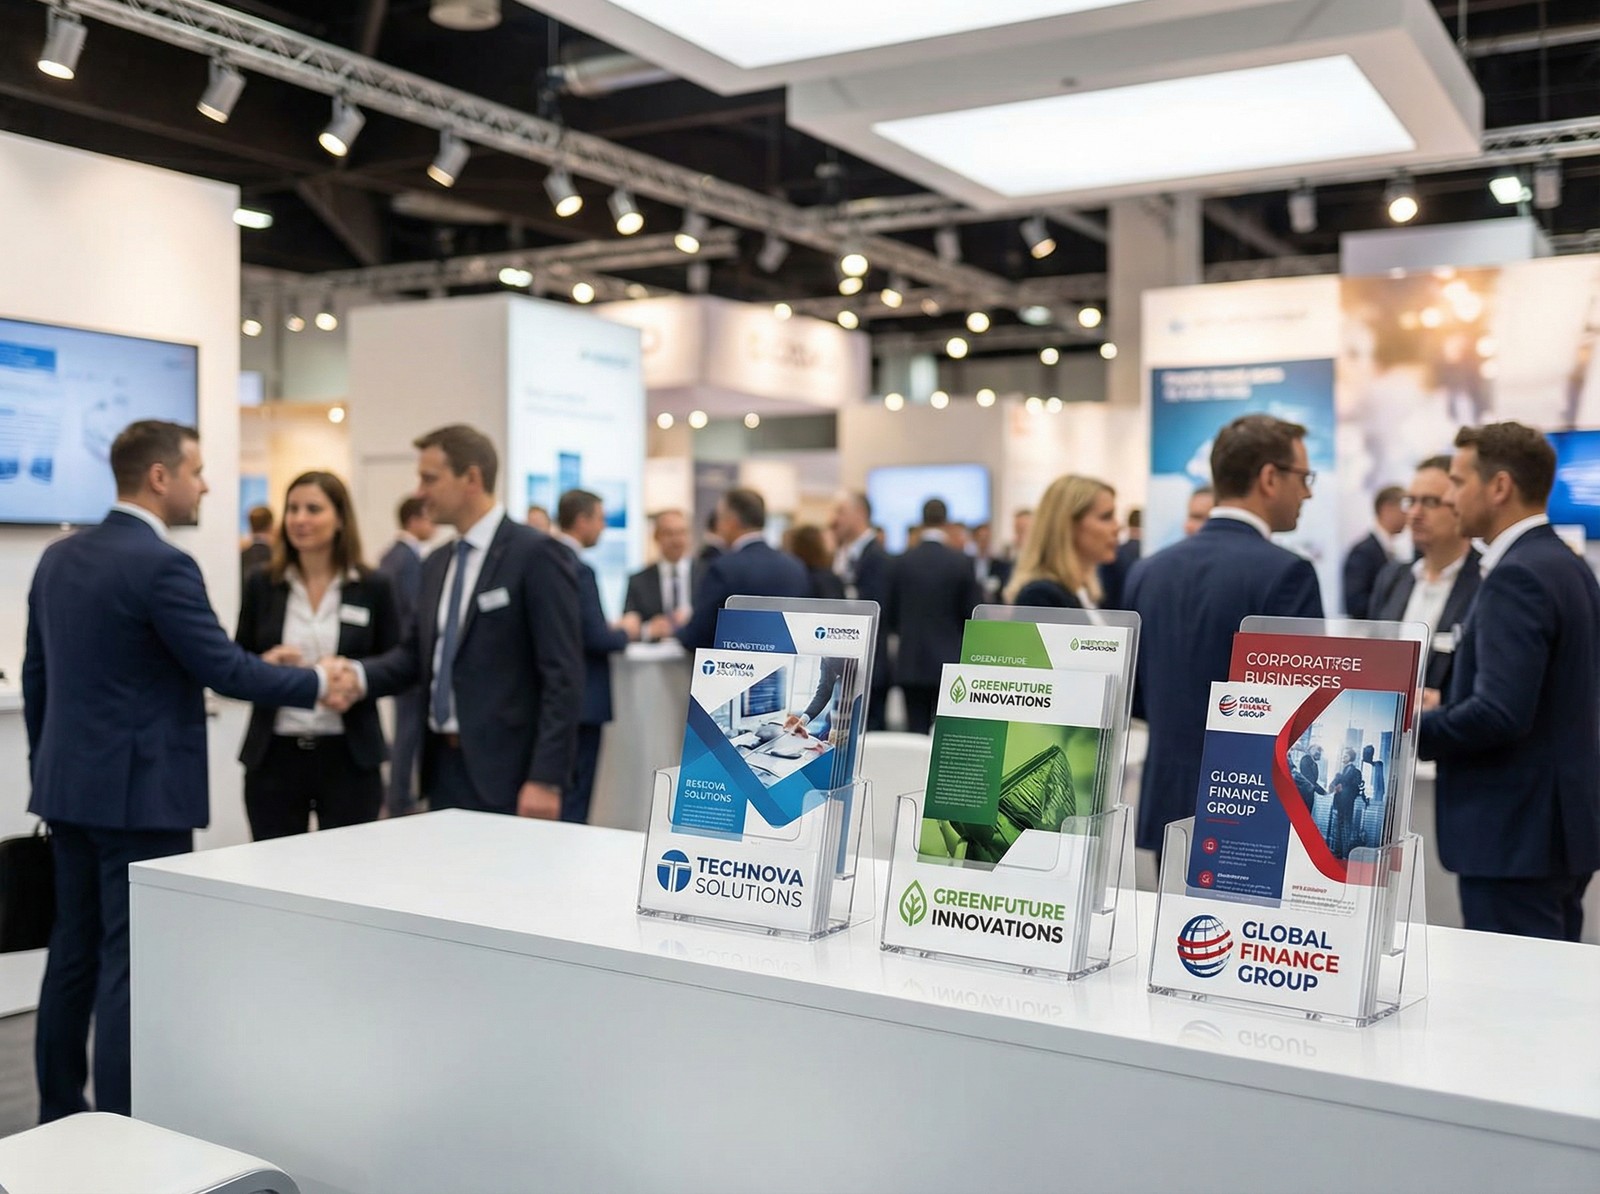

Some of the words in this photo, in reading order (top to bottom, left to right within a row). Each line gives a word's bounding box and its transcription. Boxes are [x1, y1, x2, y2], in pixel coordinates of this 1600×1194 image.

[971, 679, 1053, 695] GREENFUTURE
[1244, 671, 1341, 689] BUSINESSES
[969, 692, 1051, 708] INNOVATIONS
[1239, 696, 1270, 705] GLOBAL
[1238, 710, 1266, 718] GROUP
[1210, 770, 1266, 787] GLOBAL
[684, 789, 732, 803] SOLUTIONS
[1208, 786, 1270, 803] FINANCE
[1206, 801, 1256, 817] GROUP
[697, 857, 804, 887] TECHNOVA
[695, 878, 803, 908] SOLUTIONS
[933, 888, 1066, 921] GREENFUTURE
[931, 909, 1064, 944] INNOVATIONS
[1242, 920, 1333, 950] GLOBAL
[1239, 943, 1340, 974] FINANCE
[1237, 965, 1318, 992] GROUP
